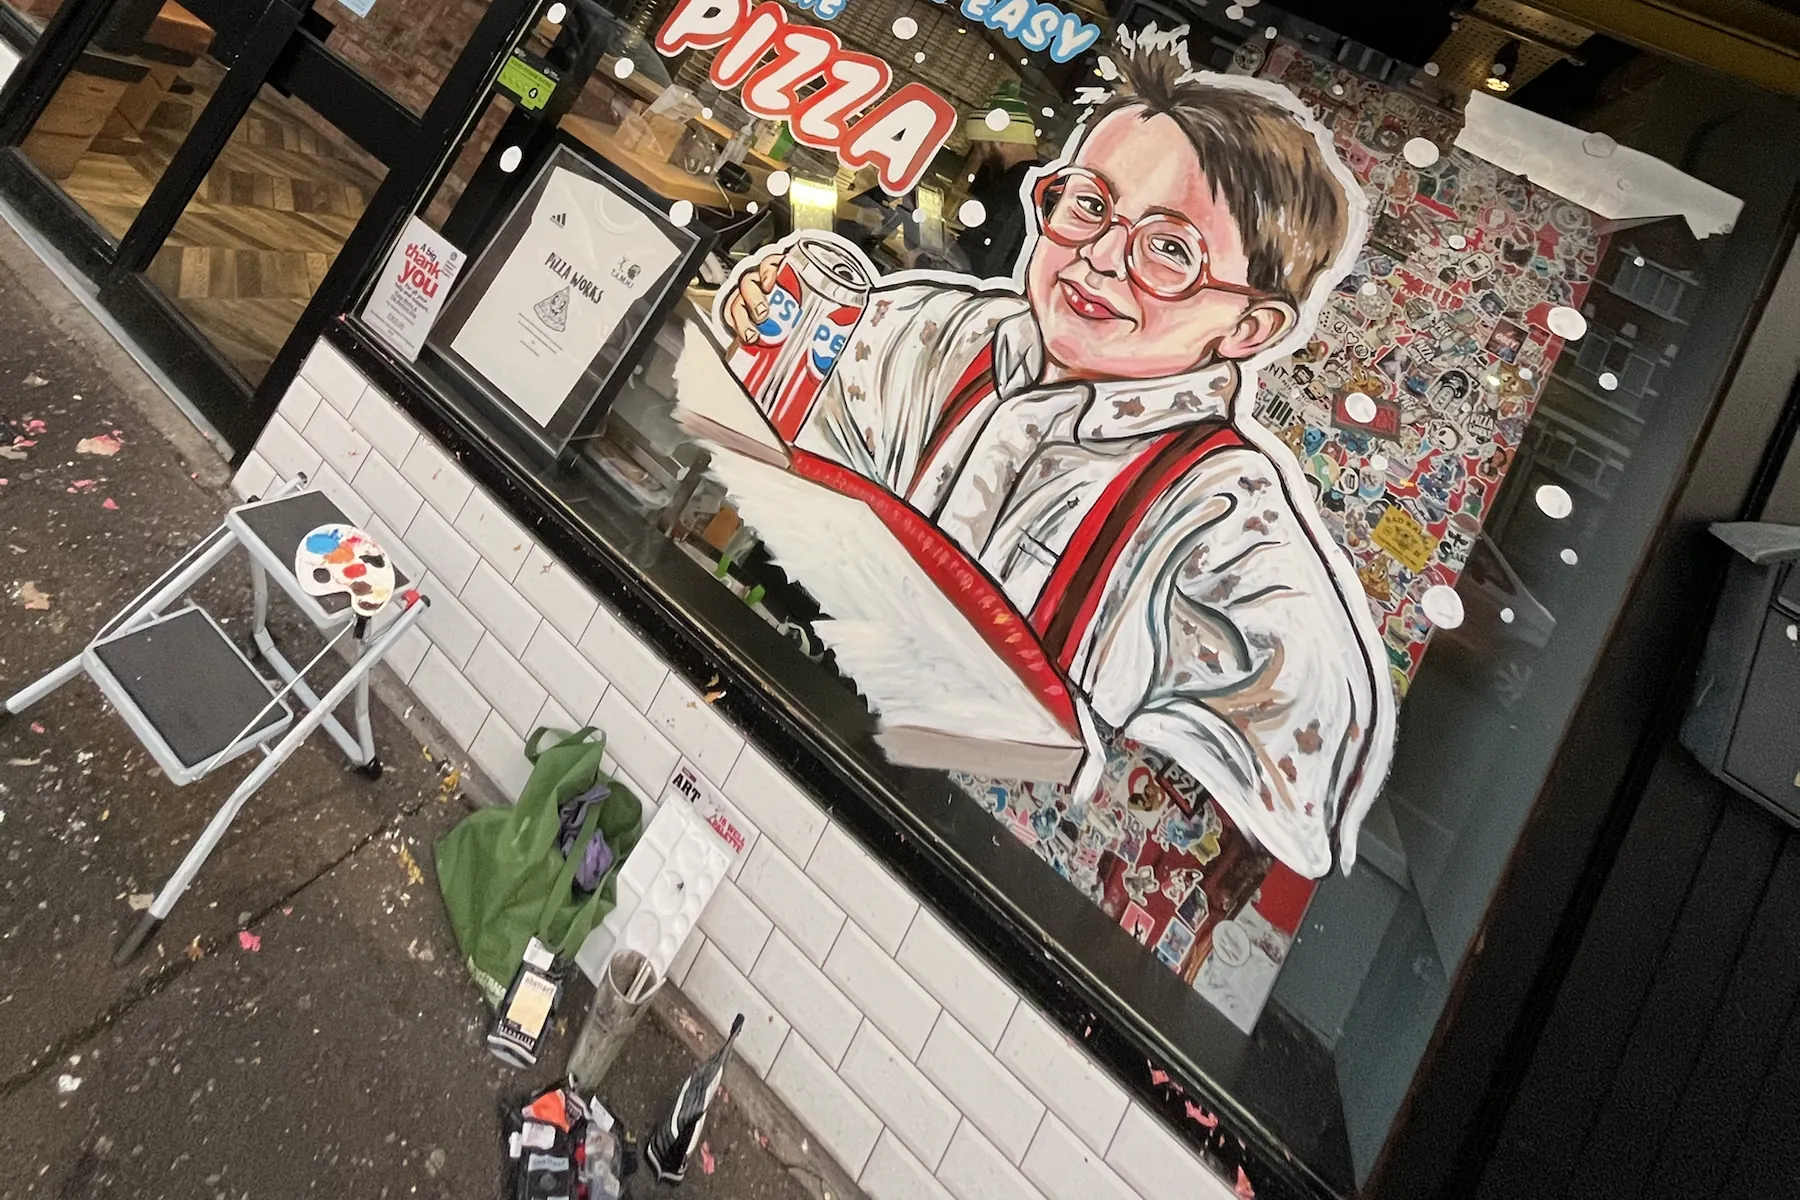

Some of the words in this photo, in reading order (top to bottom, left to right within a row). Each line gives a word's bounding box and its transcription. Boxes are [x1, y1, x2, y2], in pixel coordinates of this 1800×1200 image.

[404, 243, 440, 279] thank
[420, 243, 427, 253] A
[426, 246, 437, 260] big
[397, 260, 439, 298] you
[569, 272, 604, 304] WORKS
[672, 772, 701, 803] ART
